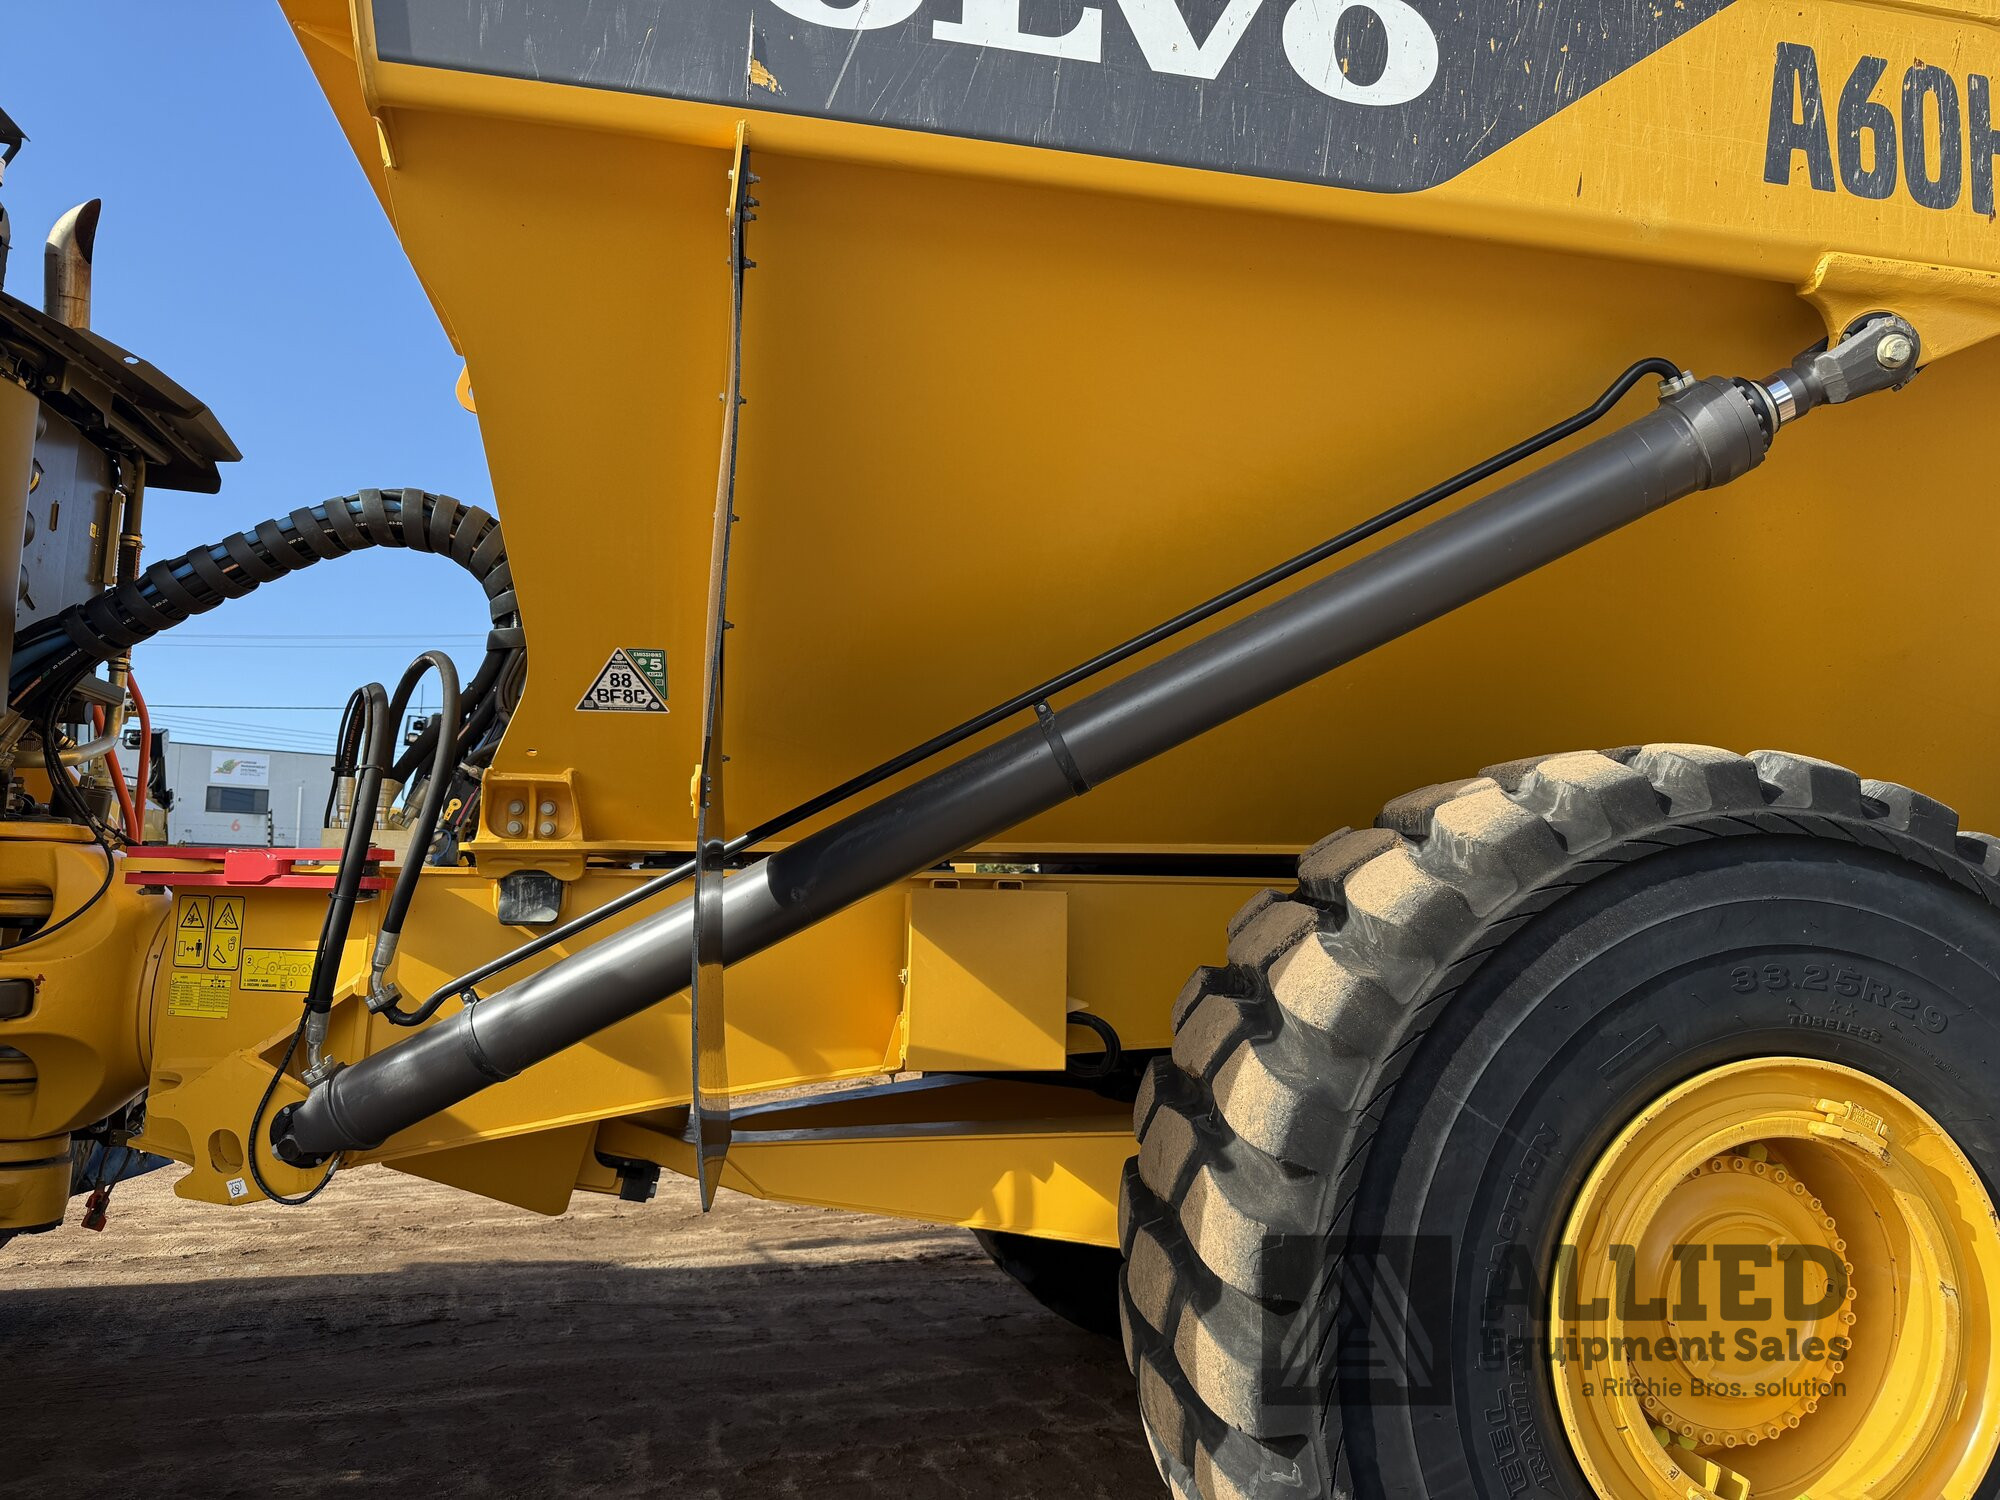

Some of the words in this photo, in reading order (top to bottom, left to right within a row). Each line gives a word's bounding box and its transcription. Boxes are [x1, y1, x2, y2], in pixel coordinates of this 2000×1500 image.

[649, 658, 662, 671] 5
[609, 673, 632, 688] 88
[597, 688, 647, 704] BF8C
[230, 819, 241, 832] 6
[1729, 963, 1949, 1034] 33.25R29
[1787, 1012, 1883, 1044] TUBELESS
